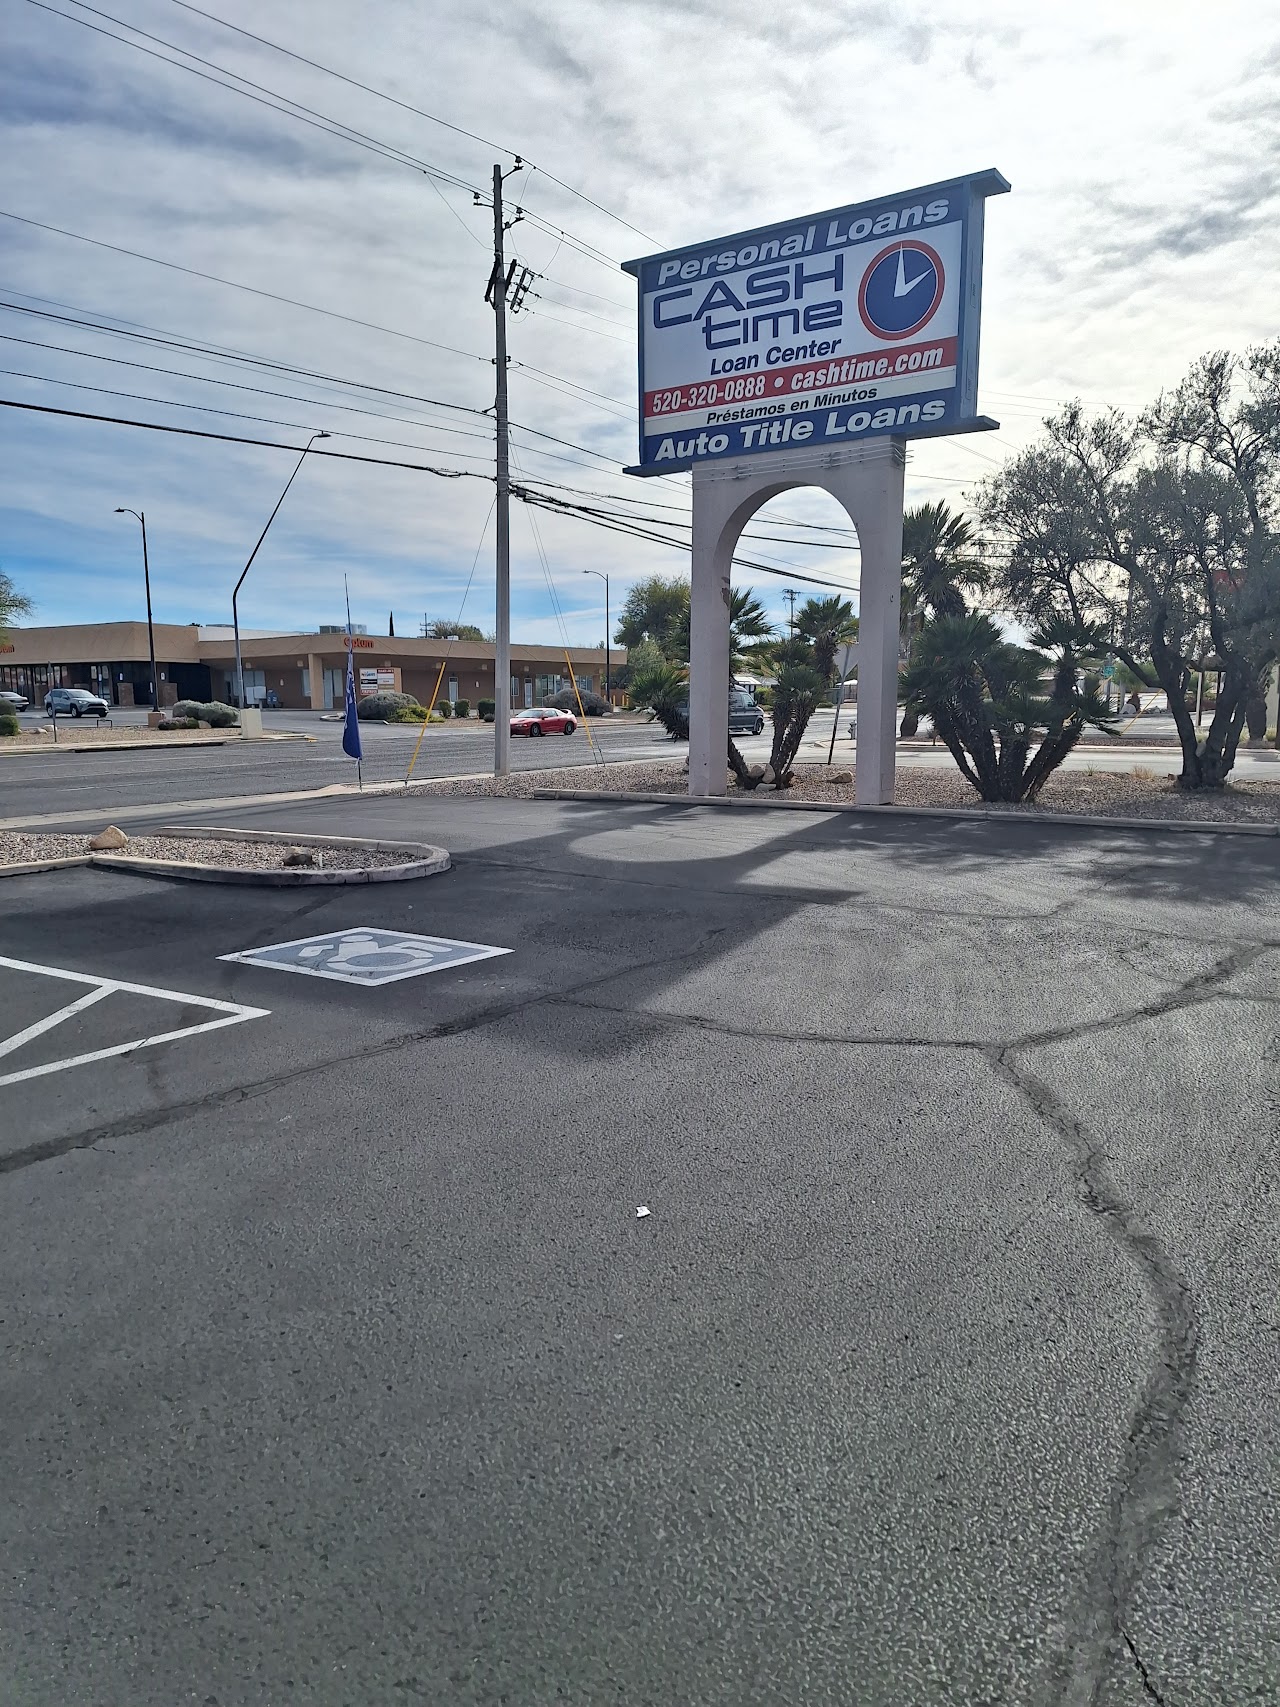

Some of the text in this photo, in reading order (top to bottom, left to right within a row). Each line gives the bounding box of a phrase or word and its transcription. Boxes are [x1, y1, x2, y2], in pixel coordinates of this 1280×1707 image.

[658, 199, 950, 286] Personal Loans
[653, 254, 844, 329] CASH
[702, 300, 843, 350] time
[652, 345, 944, 413] 520-320-0888 cashtime.com
[711, 339, 842, 376] Loan Center
[654, 399, 946, 462] Auto Title Loans
[706, 388, 878, 425] Préstamos en Minutos
